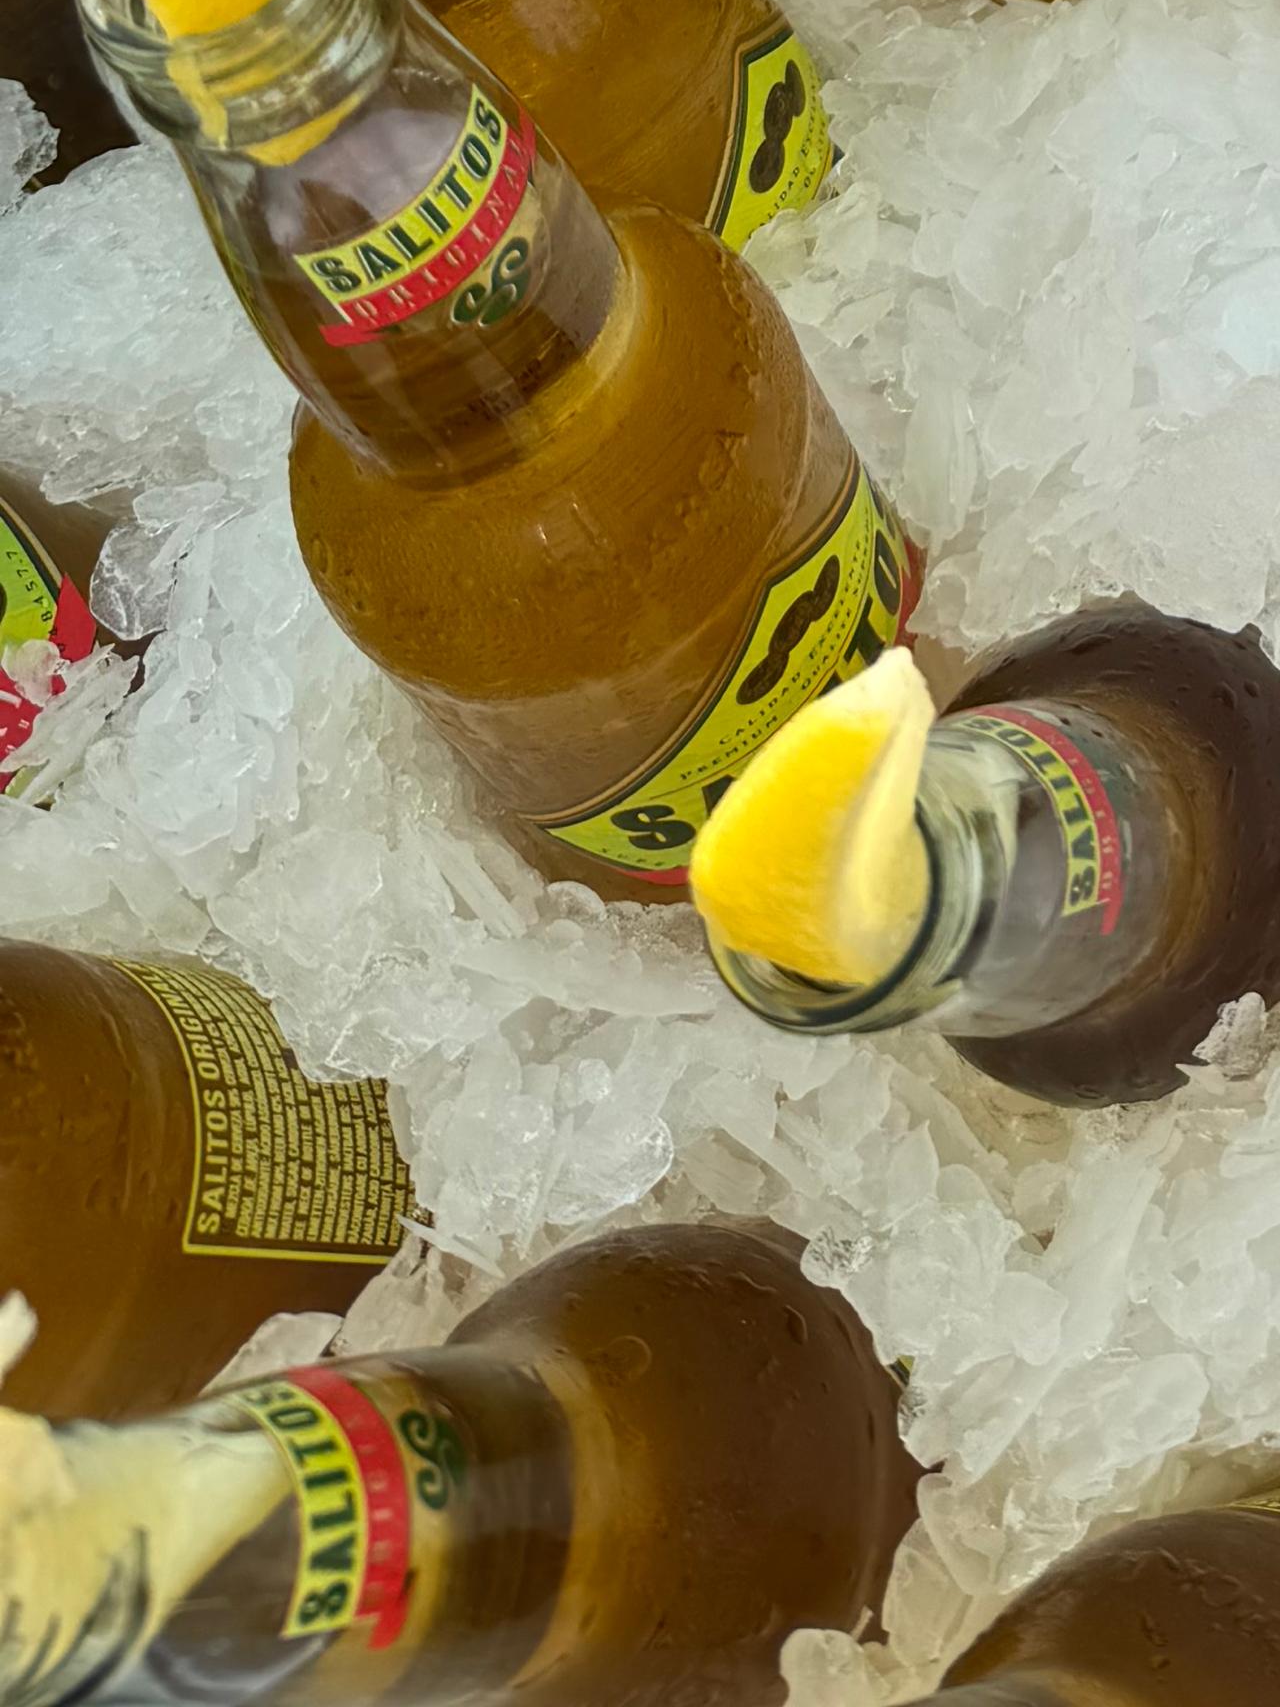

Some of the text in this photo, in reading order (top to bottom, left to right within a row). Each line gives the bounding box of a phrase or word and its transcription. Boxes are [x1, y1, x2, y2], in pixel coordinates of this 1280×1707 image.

[312, 98, 502, 294] SALITOS
[679, 714, 780, 781] PREMIUM
[719, 671, 803, 746] CALIDAD
[197, 1088, 228, 1235] SALITOS
[247, 1387, 356, 1625] SALITOS
